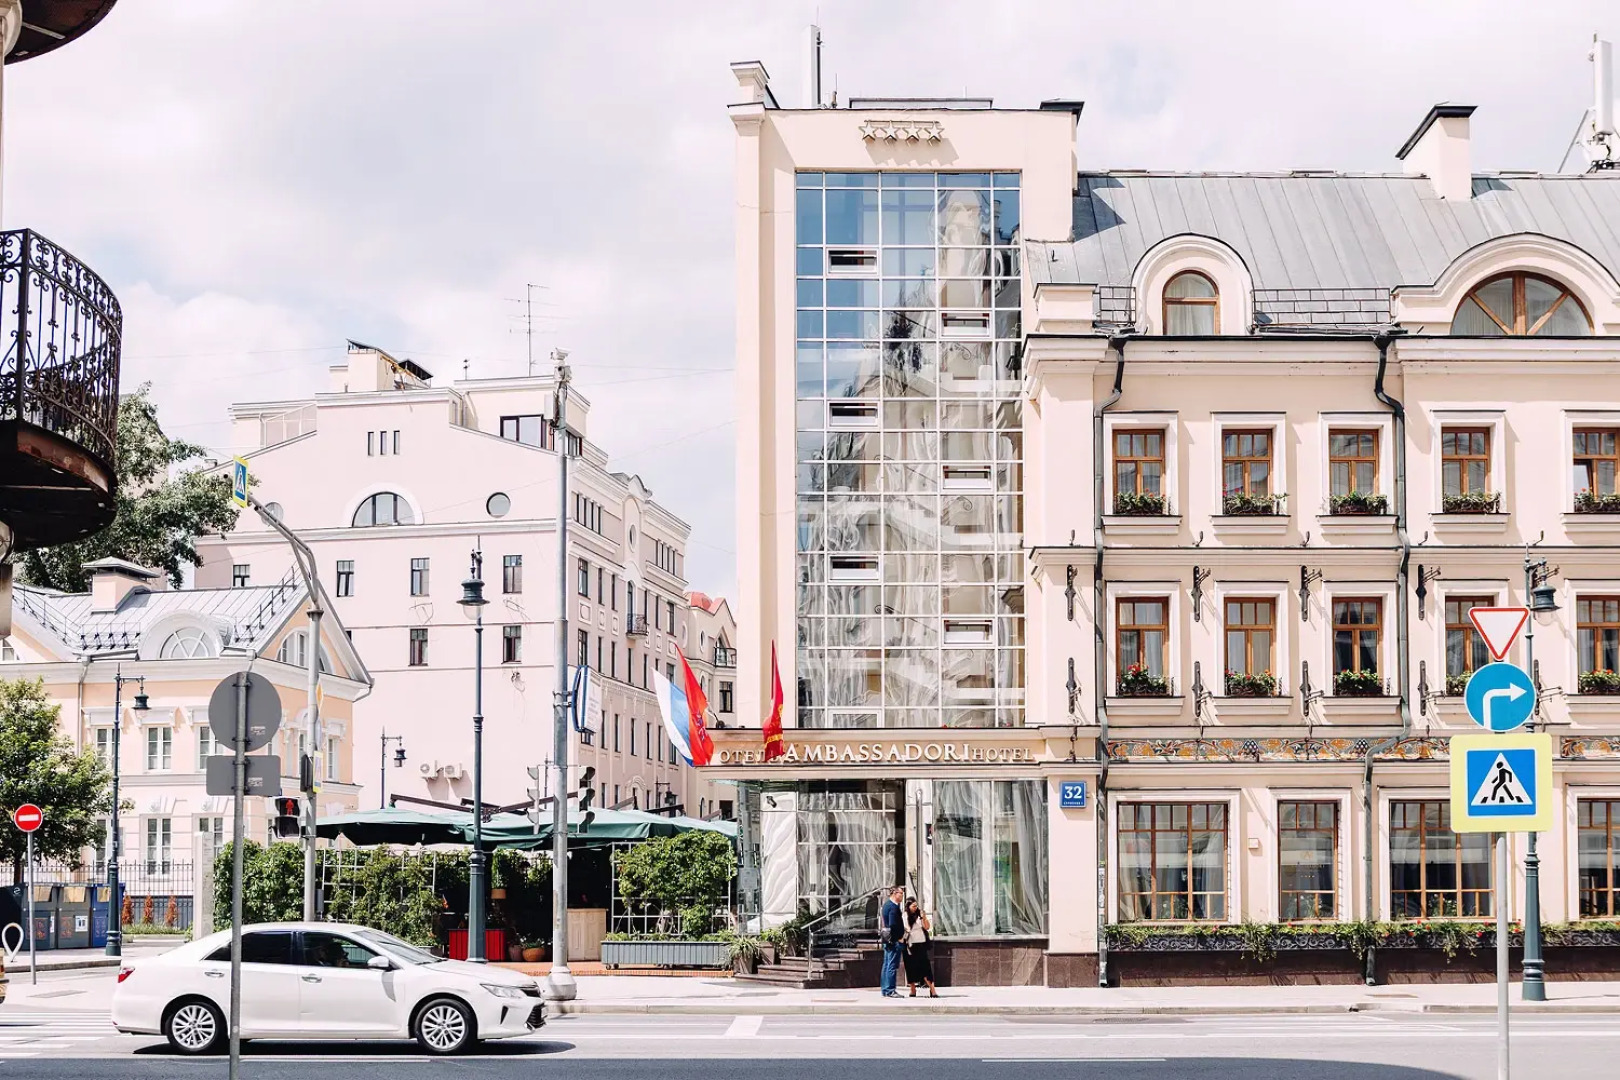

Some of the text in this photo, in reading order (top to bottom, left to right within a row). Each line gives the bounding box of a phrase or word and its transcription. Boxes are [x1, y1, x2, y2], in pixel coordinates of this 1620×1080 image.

[784, 742, 970, 762] AMBASSADORI
[971, 748, 1035, 762] HOTEL
[1064, 785, 1082, 799] 32
